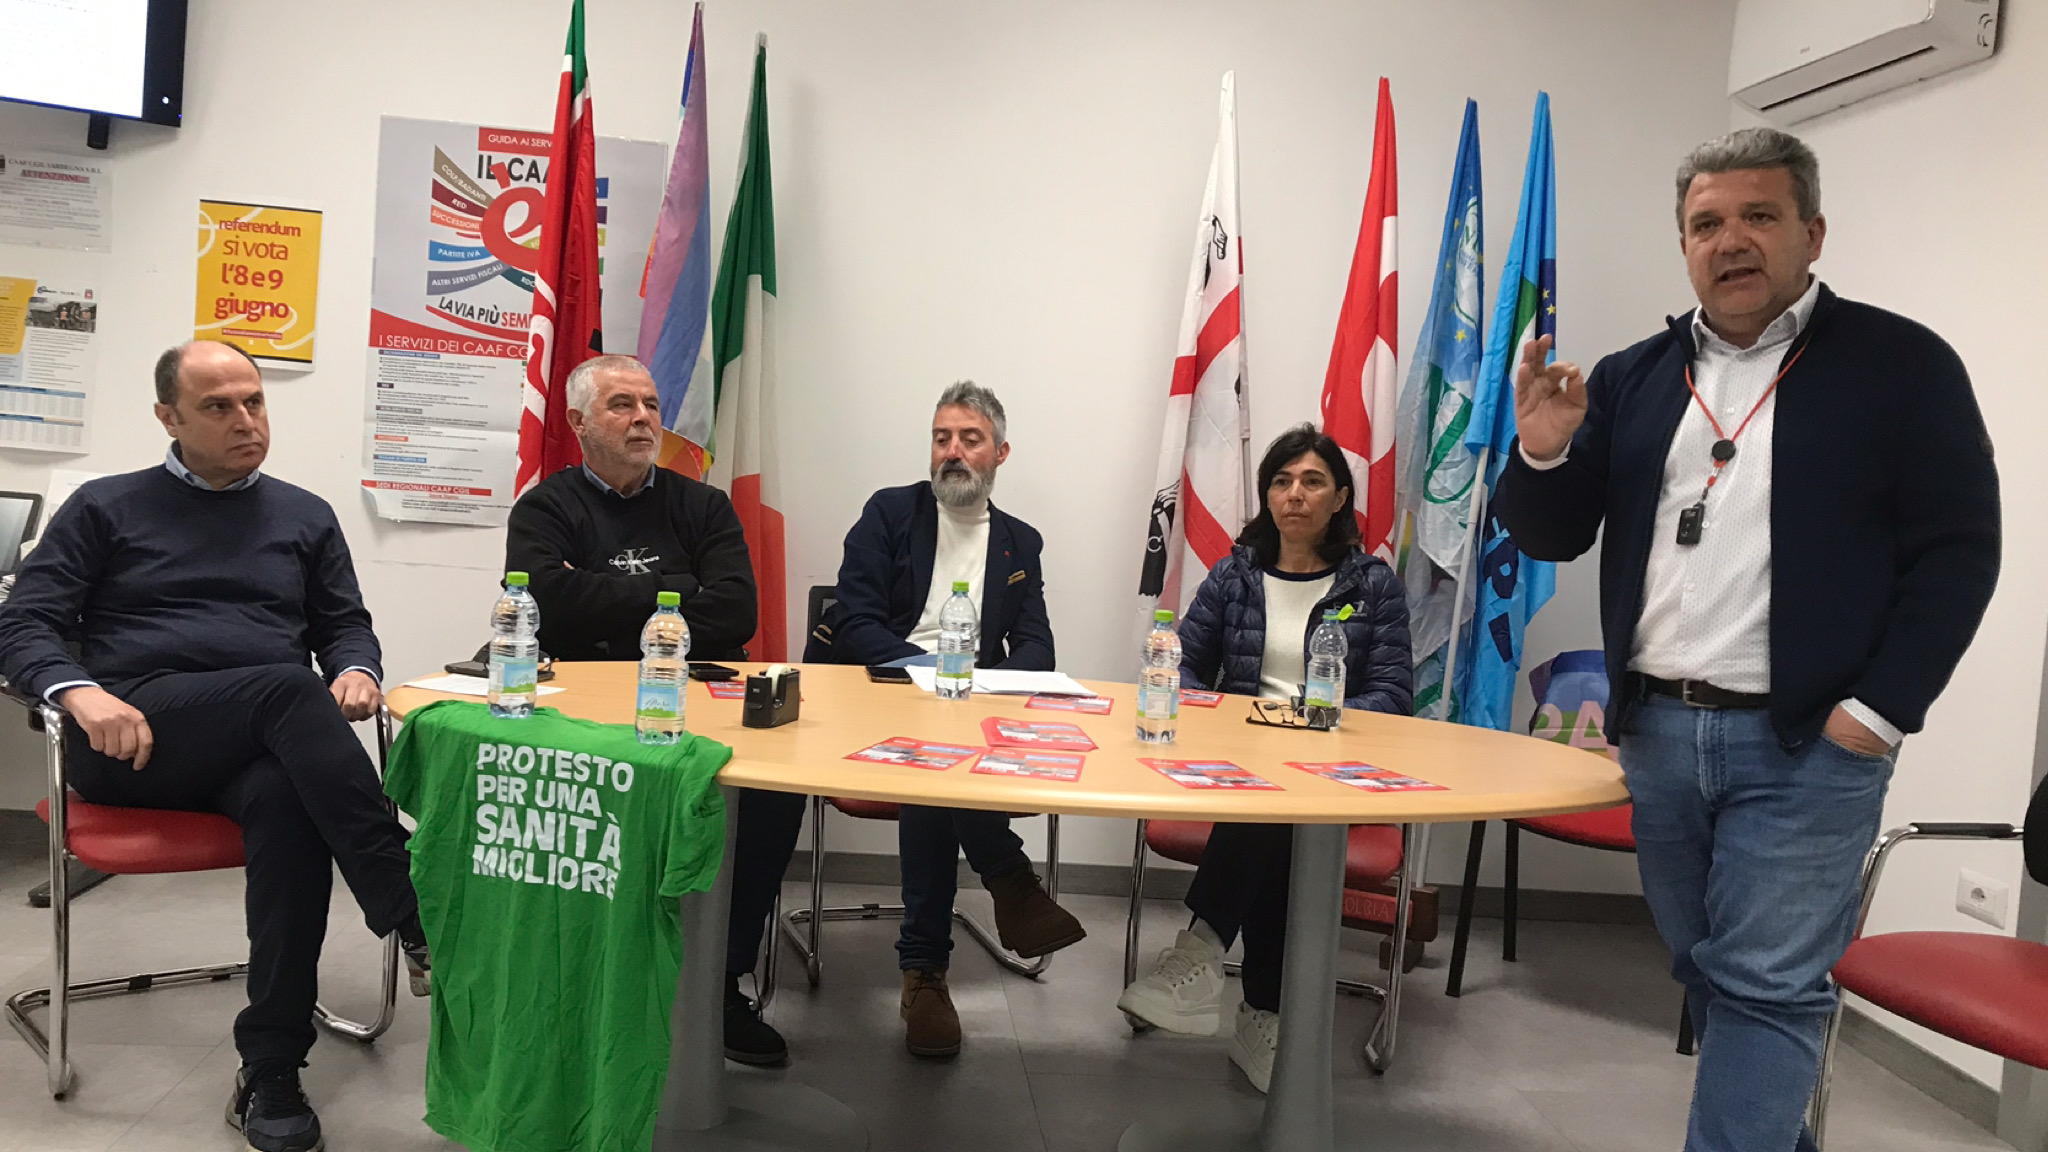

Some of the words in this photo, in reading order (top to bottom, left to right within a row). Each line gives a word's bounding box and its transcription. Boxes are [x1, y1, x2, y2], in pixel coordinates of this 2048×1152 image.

[489, 134, 519, 146] GUIDA
[520, 137, 529, 146] AI
[478, 154, 497, 180] IL
[452, 198, 468, 209] RED
[219, 217, 302, 237] referendum
[431, 209, 480, 230] SUCCESSIONI
[222, 234, 239, 256] si
[243, 241, 289, 260] vota
[437, 248, 466, 259] PARTITE
[467, 249, 481, 258] IVA
[251, 270, 266, 287] e
[268, 269, 284, 290] 9
[431, 277, 451, 287] ALTRI
[452, 273, 478, 286] SERVIZI
[478, 263, 504, 278] FISCALI
[214, 292, 290, 323] giugno
[438, 296, 454, 313] LA
[454, 301, 475, 318] VIA
[477, 304, 501, 325] PIÙ
[379, 334, 383, 346] I
[386, 335, 434, 350] SERVIZI
[437, 340, 459, 352] DEI
[463, 342, 503, 356] CAAF
[476, 743, 635, 792] PROTESTO
[476, 774, 528, 805] PER
[534, 779, 603, 817] UNA
[476, 802, 622, 870] SANITÀ
[473, 844, 619, 901] MIGLIORE
